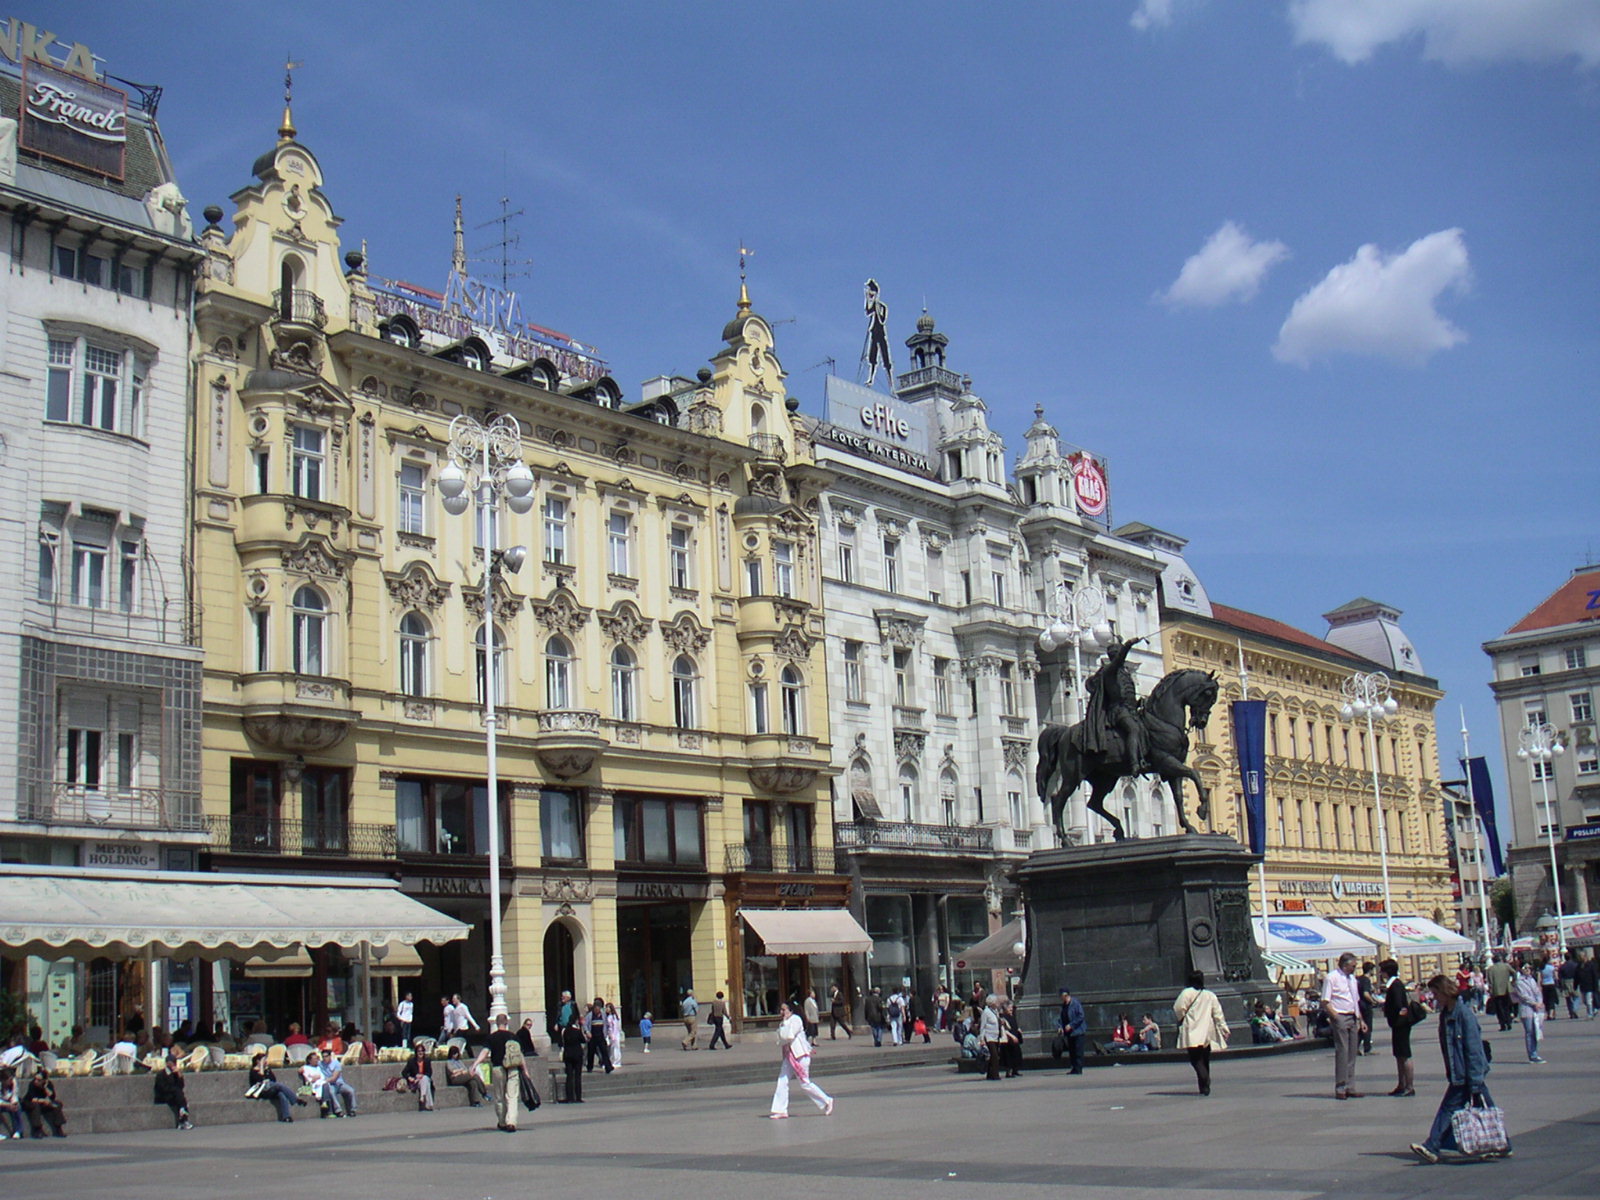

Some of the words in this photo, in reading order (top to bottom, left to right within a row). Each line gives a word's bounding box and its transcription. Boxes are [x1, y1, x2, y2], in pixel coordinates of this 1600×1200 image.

[28, 82, 125, 131] Franck
[831, 429, 861, 447] FOTO
[867, 442, 932, 471] MATERIJAL
[95, 844, 142, 855] METRO
[89, 855, 148, 866] HOLDING
[422, 879, 485, 894] HARMICA
[1344, 882, 1384, 895] VARTEKS
